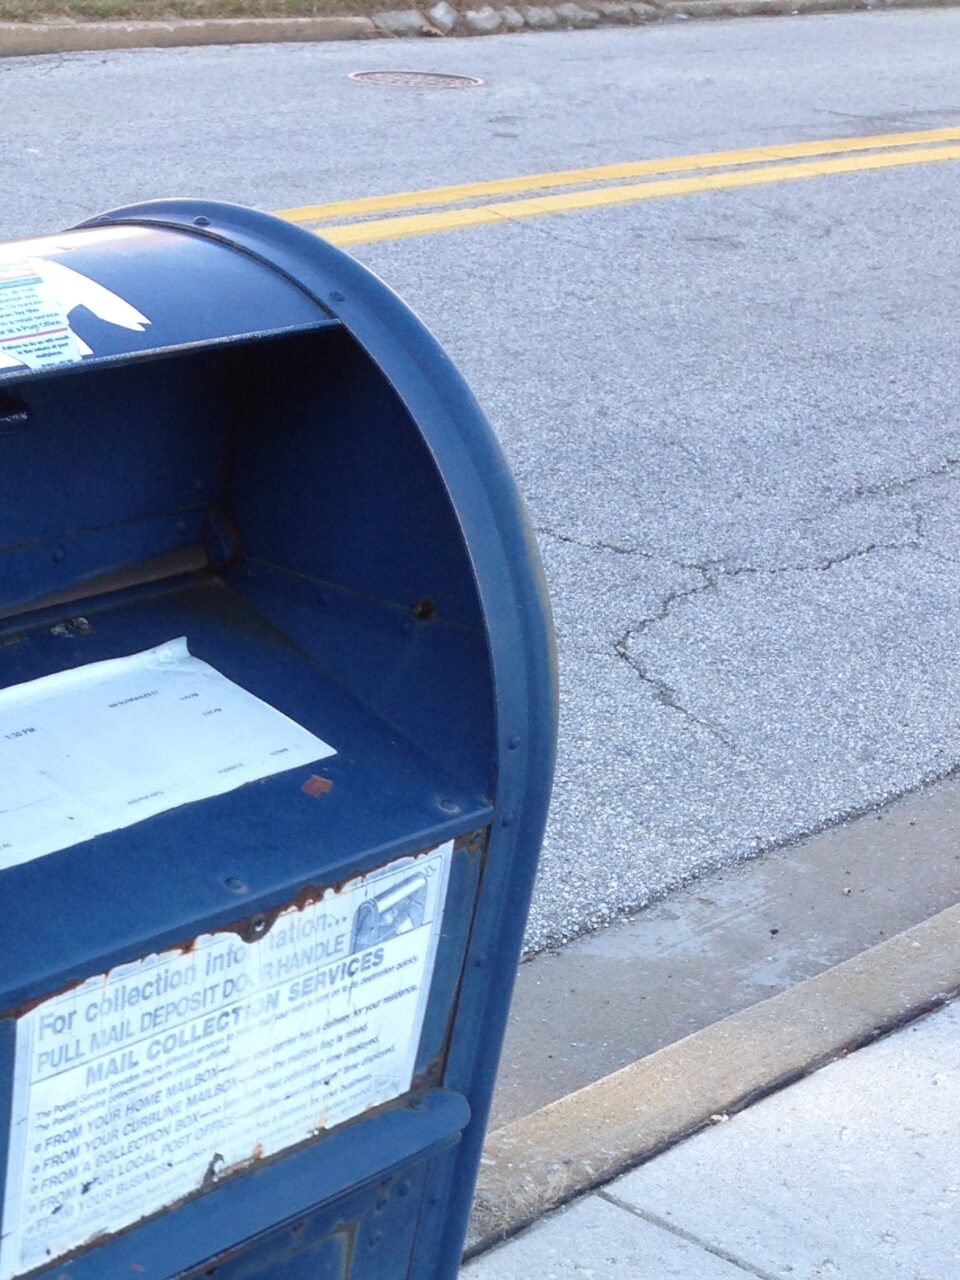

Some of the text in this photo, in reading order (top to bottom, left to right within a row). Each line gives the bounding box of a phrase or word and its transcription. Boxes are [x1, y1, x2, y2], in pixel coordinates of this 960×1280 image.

[36, 892, 351, 1043] For collection infoation...
[36, 1034, 87, 1075] PULL
[88, 1014, 137, 1055] MAIL
[138, 980, 220, 1035] DEPOSIT
[221, 958, 275, 1001] DOR
[275, 929, 348, 979] HANDLE
[84, 1044, 141, 1089] MAIL
[286, 942, 387, 1005] SERVICES
[41, 1141, 82, 1174] FROM
[82, 1125, 120, 1156] YOUR
[121, 1097, 184, 1138] CURBLINE
[43, 1121, 84, 1153] FROM
[84, 1105, 122, 1135] YOUR
[124, 1088, 163, 1118] HOME
[51, 1107, 78, 1129] Postal
[78, 1096, 107, 1117] Service
[52, 1094, 78, 1116] Postal
[78, 1082, 108, 1105] Service
[38, 1183, 77, 1213] FROM
[77, 1165, 115, 1196] UR
[117, 1146, 159, 1178] LOCAL
[159, 1131, 192, 1159] POST
[40, 1162, 80, 1194] FROM
[81, 1157, 92, 1174] A
[94, 1121, 172, 1170] COLLECTION
[77, 1186, 114, 1214] YOUR
